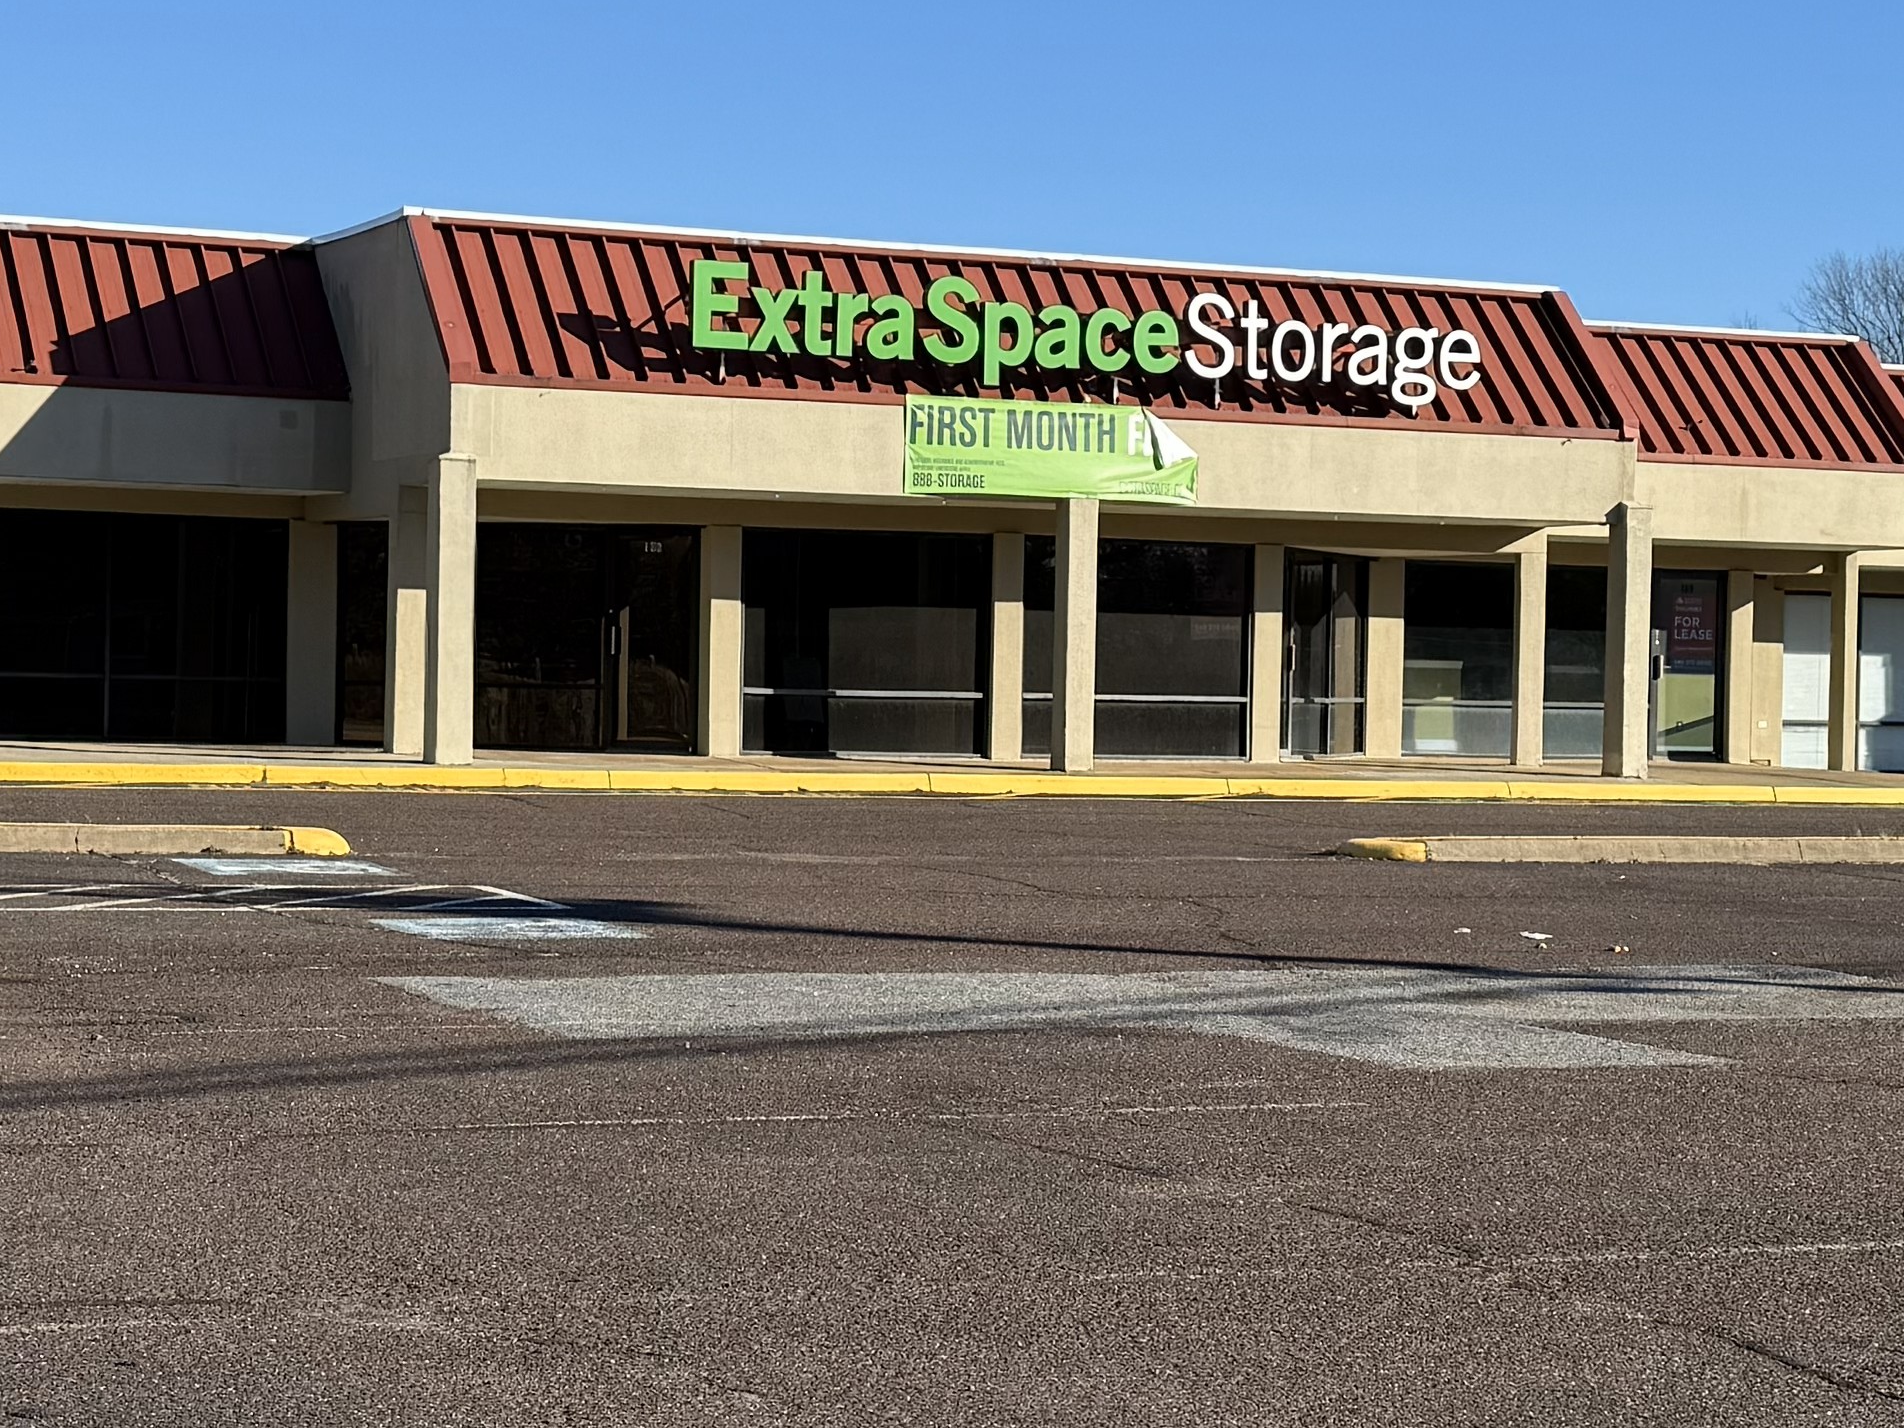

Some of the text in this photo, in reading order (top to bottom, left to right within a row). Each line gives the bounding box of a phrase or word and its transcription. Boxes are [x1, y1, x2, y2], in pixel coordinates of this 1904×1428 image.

[909, 404, 995, 449] FIRST
[1007, 409, 1116, 454] MONTH
[912, 472, 985, 489] 888-STORAGE
[1674, 616, 1701, 628] FOR
[1674, 629, 1713, 641] LEASE
